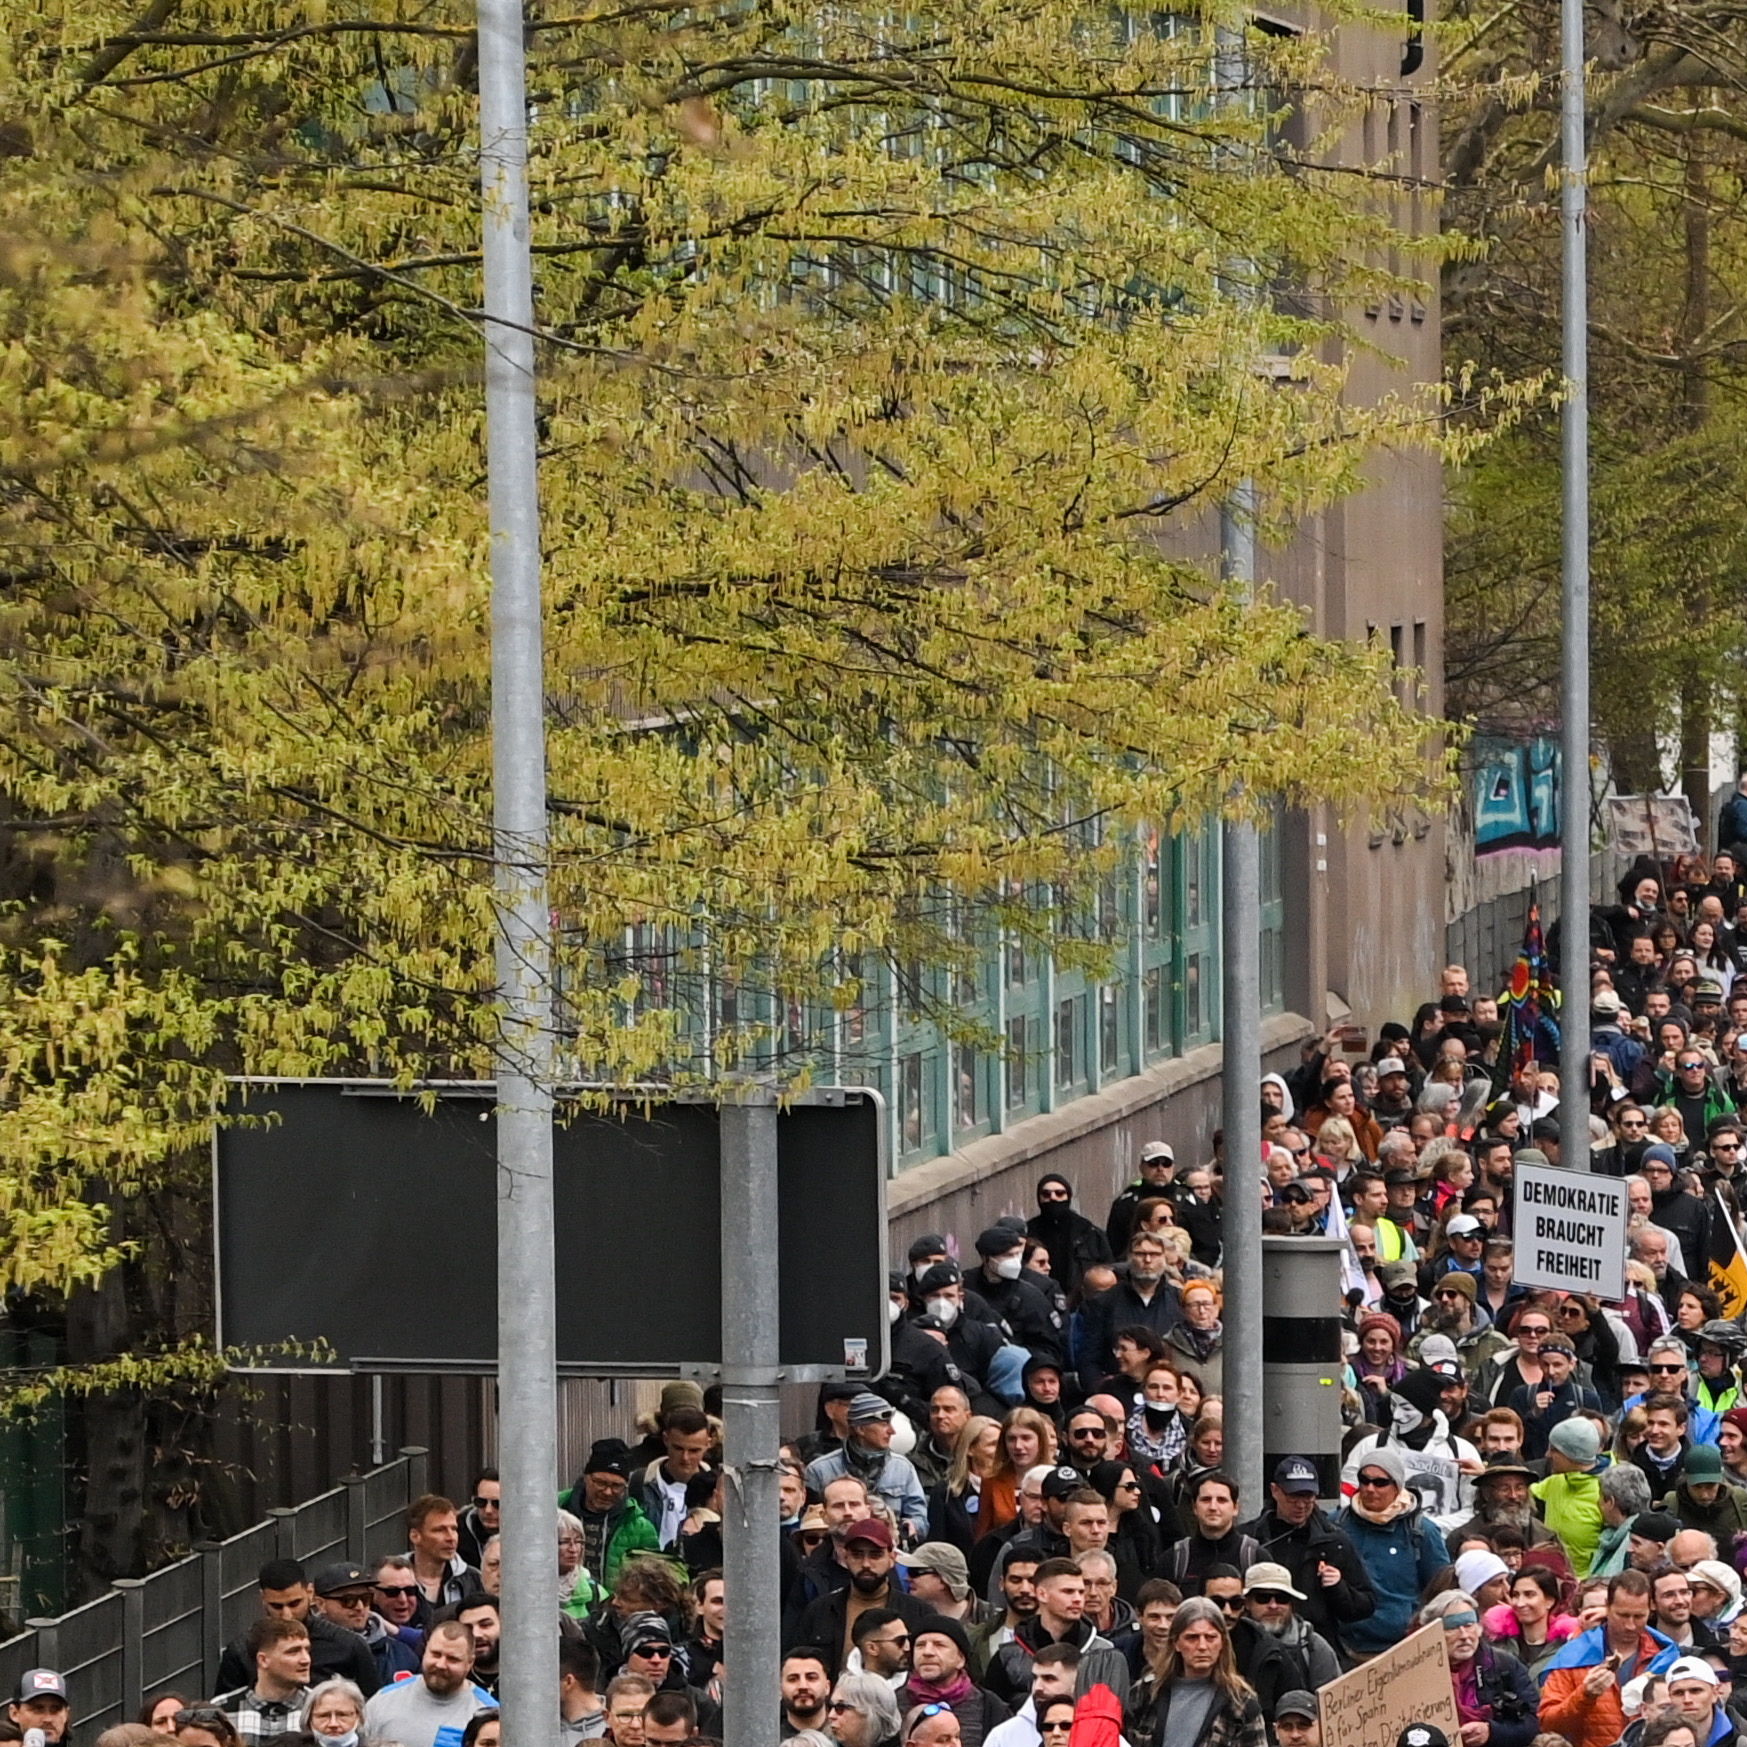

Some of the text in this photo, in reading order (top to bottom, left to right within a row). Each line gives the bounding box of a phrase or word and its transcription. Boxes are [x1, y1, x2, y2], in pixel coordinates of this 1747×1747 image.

[1523, 1180, 1619, 1217] DEMOKRATIE
[1535, 1216, 1605, 1248] BRAUCHT
[1536, 1249, 1603, 1281] FREIHEIT
[1323, 1679, 1365, 1717] Berliner
[1356, 1702, 1387, 1738] Spahn
